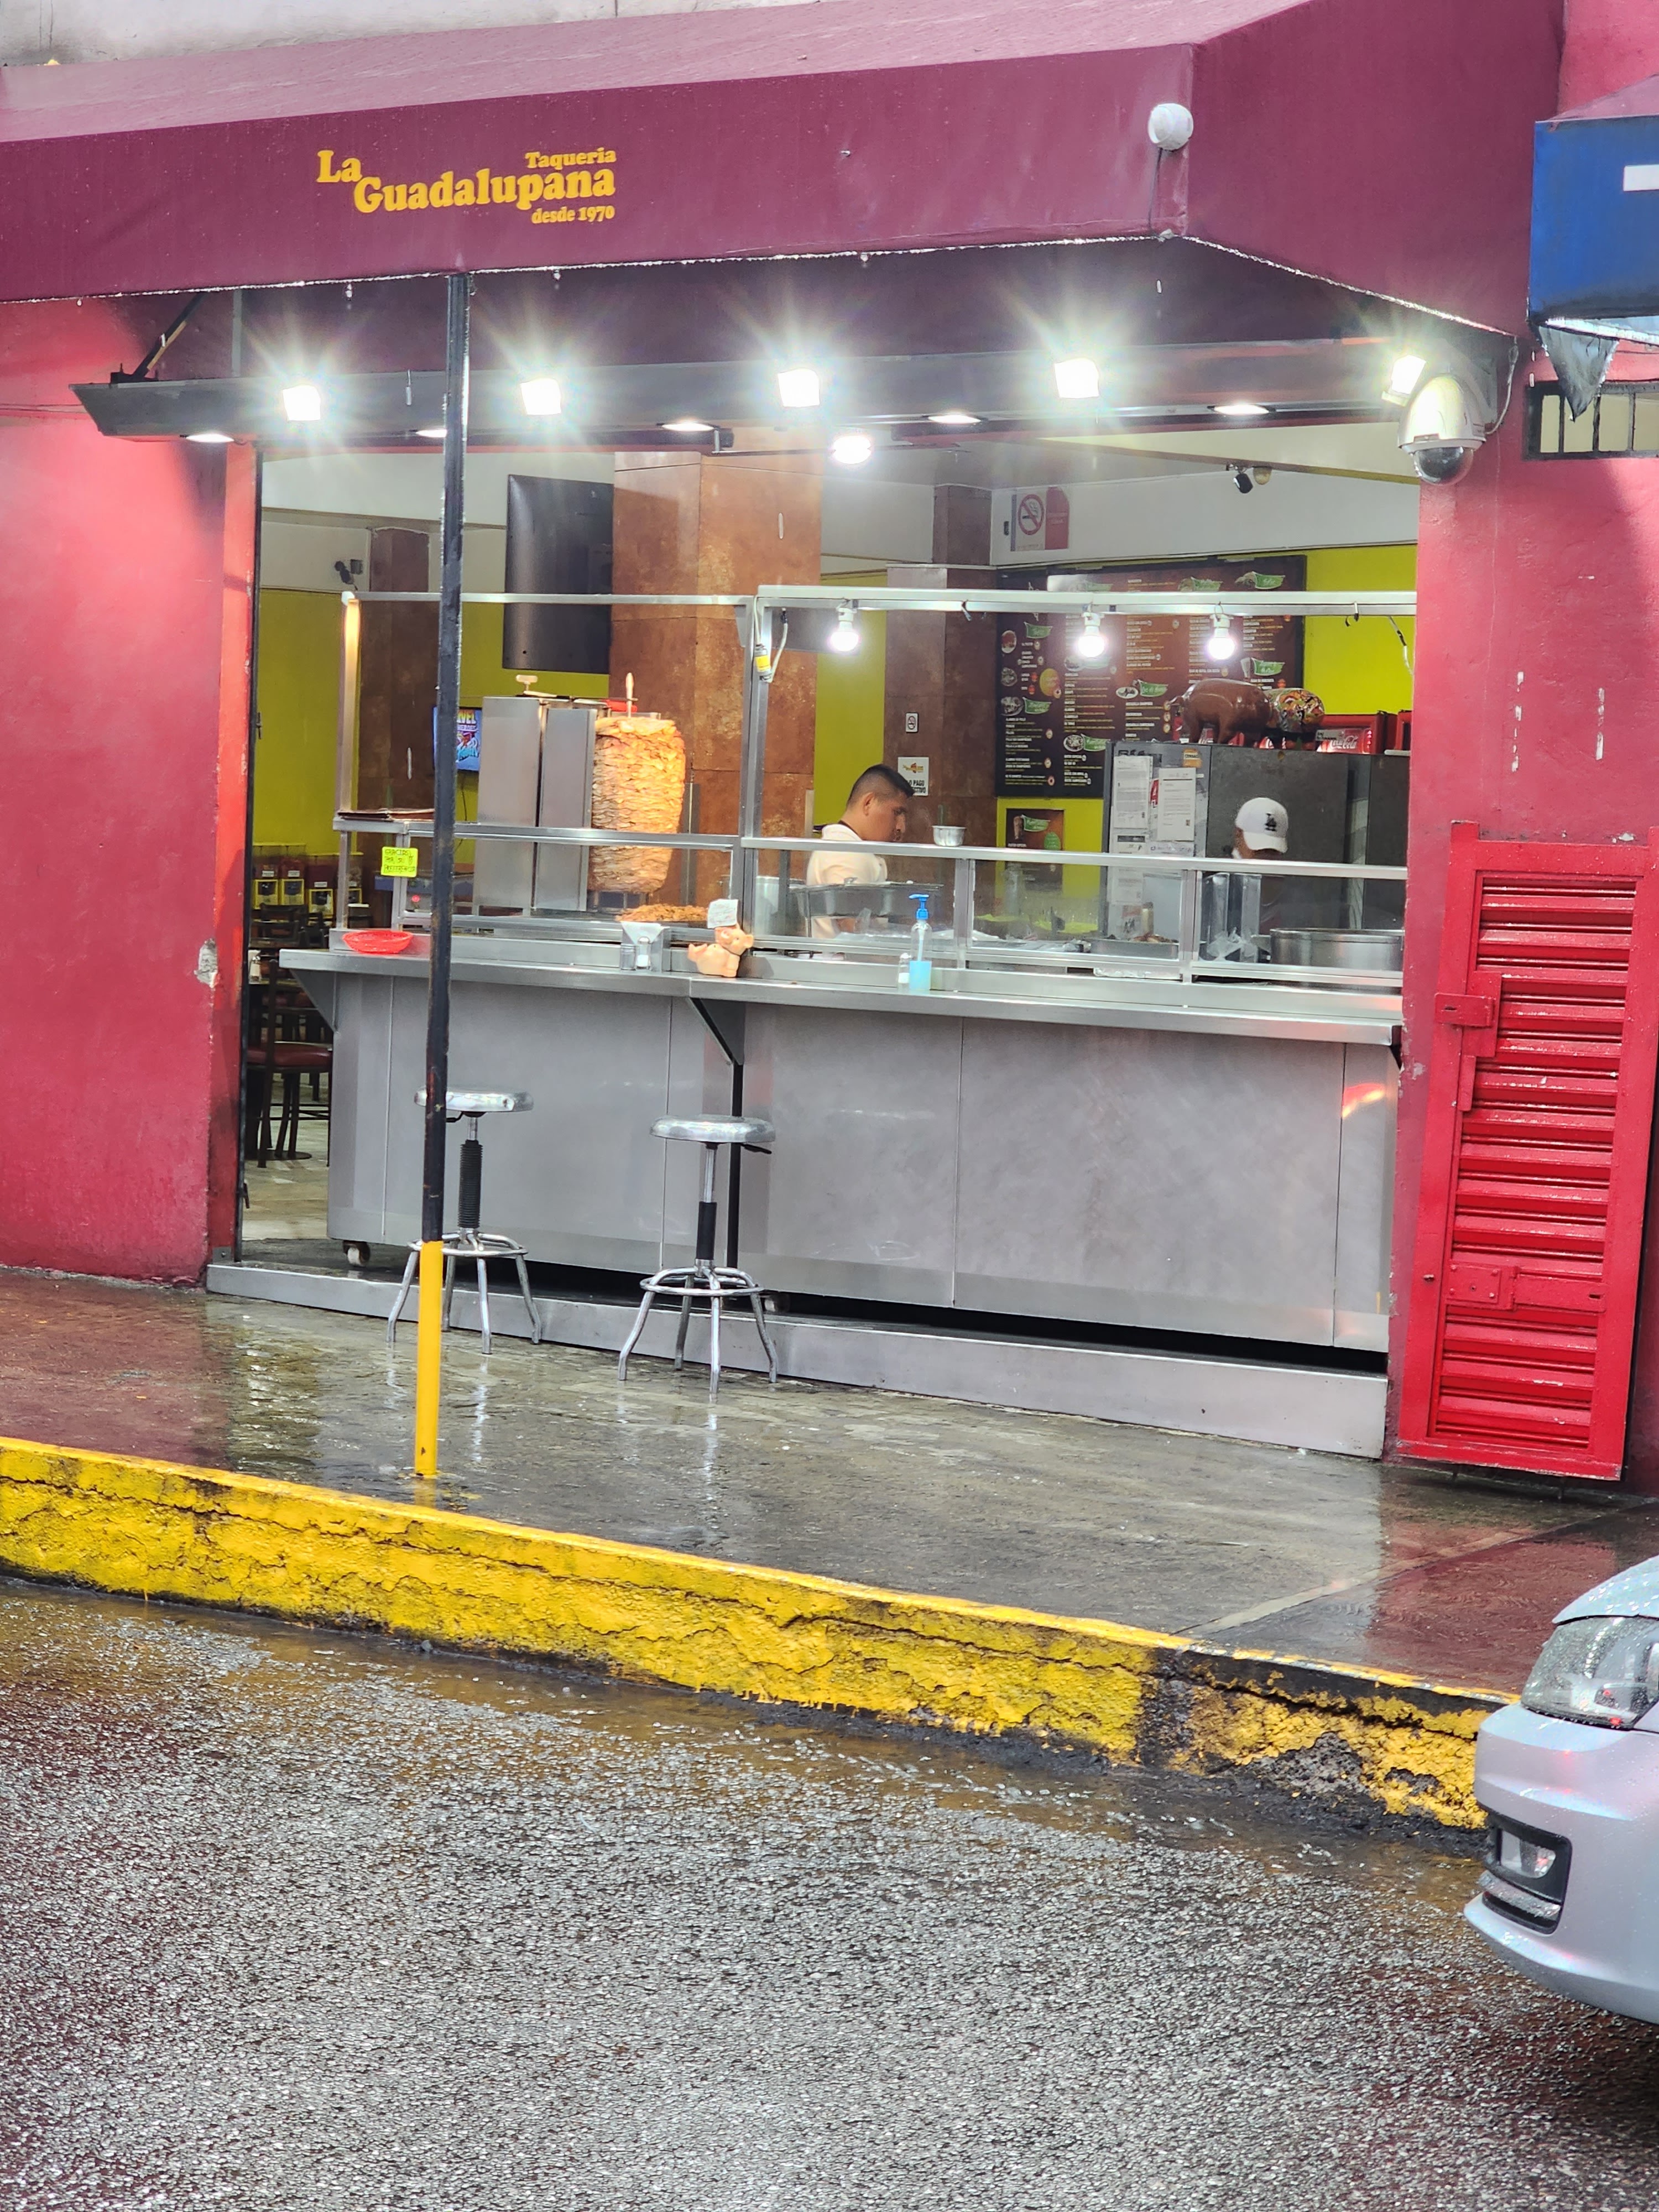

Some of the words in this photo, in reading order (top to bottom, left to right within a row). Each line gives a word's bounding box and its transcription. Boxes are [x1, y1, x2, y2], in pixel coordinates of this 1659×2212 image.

[525, 147, 617, 170] Taqueria
[316, 150, 363, 182] La
[354, 168, 615, 213] Guadalupana
[531, 206, 576, 224] desde
[578, 205, 615, 222] 1970
